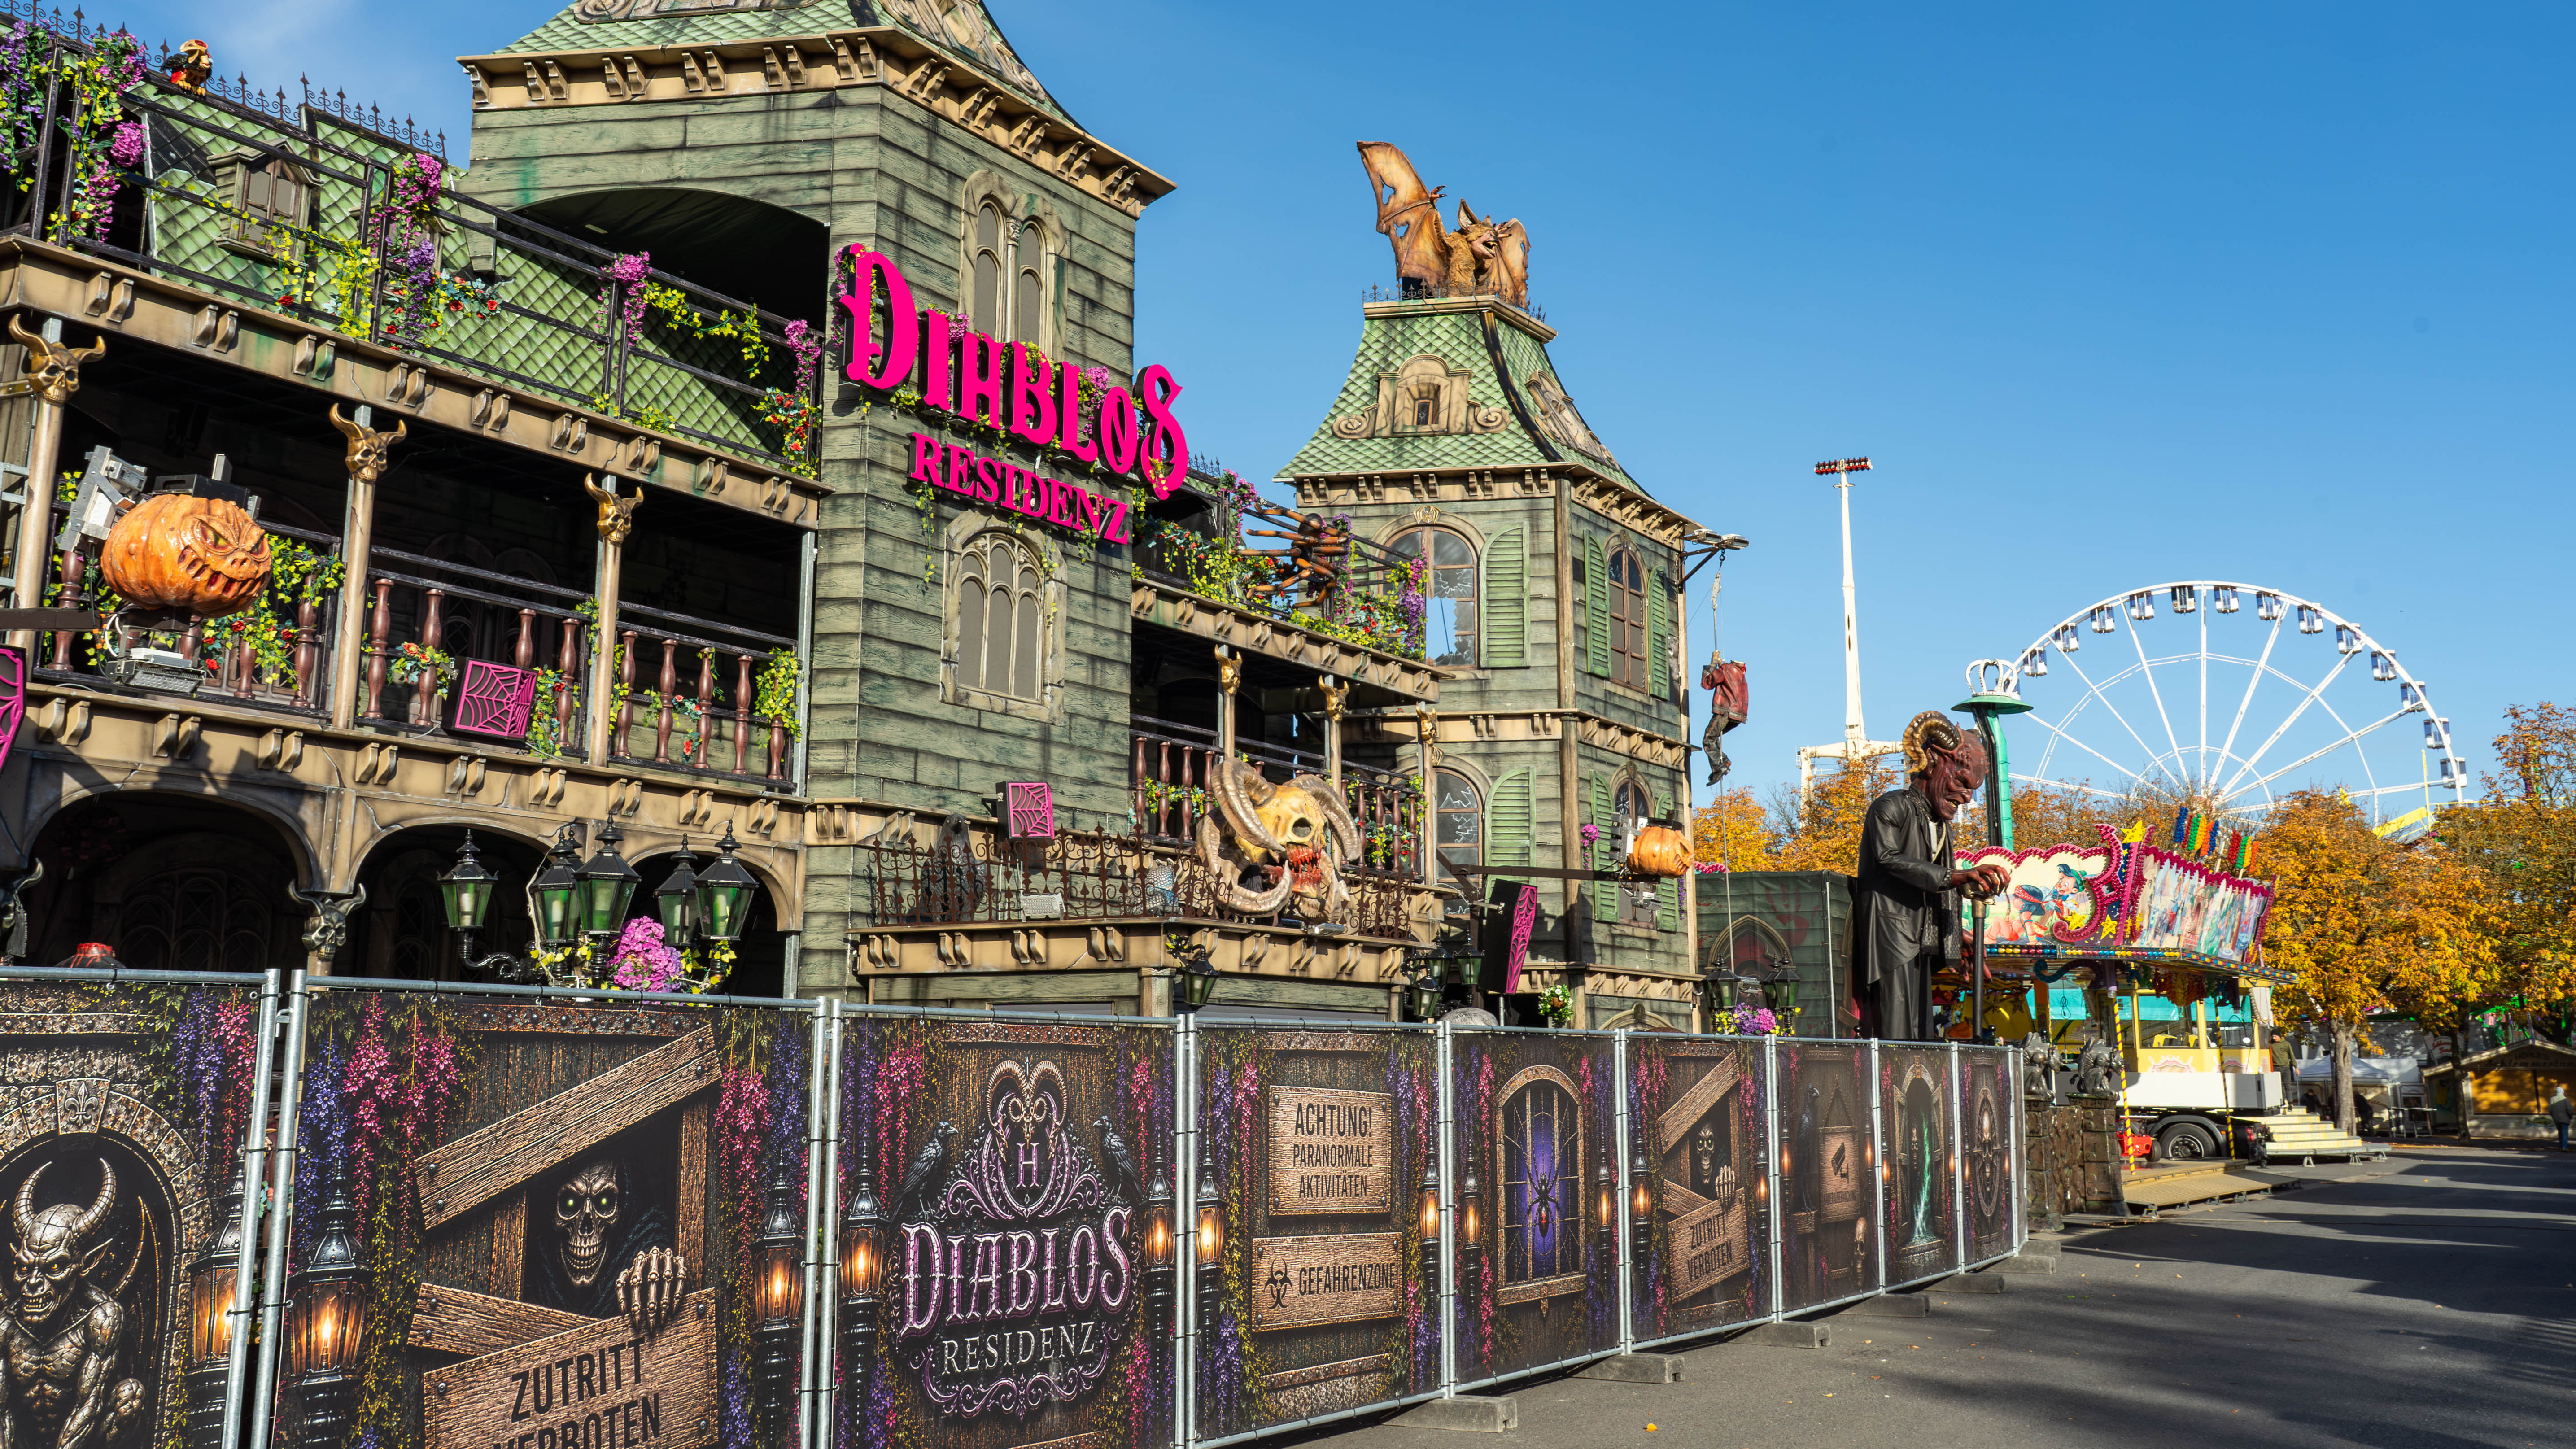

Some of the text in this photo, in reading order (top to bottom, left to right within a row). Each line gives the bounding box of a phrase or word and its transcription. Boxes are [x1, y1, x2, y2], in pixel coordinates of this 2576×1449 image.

[839, 243, 1188, 500] DIABLOS
[908, 432, 1129, 545] RESIDENZ
[1295, 1102, 1372, 1138] ACHTUNG!
[1293, 1143, 1373, 1167] PARANORMALE
[1299, 1169, 1367, 1198] AKTIVITÄTEN
[1690, 1212, 1725, 1250] ZUTRITT
[899, 1205, 1132, 1343] DIABLOS
[1299, 1262, 1395, 1296] GEFAHRENZONE
[1687, 1240, 1732, 1282] VERBOTEN
[942, 1321, 1095, 1375] RESIDENZ
[511, 1336, 645, 1423] ZUTRITT
[493, 1392, 660, 1449] BOTEN
